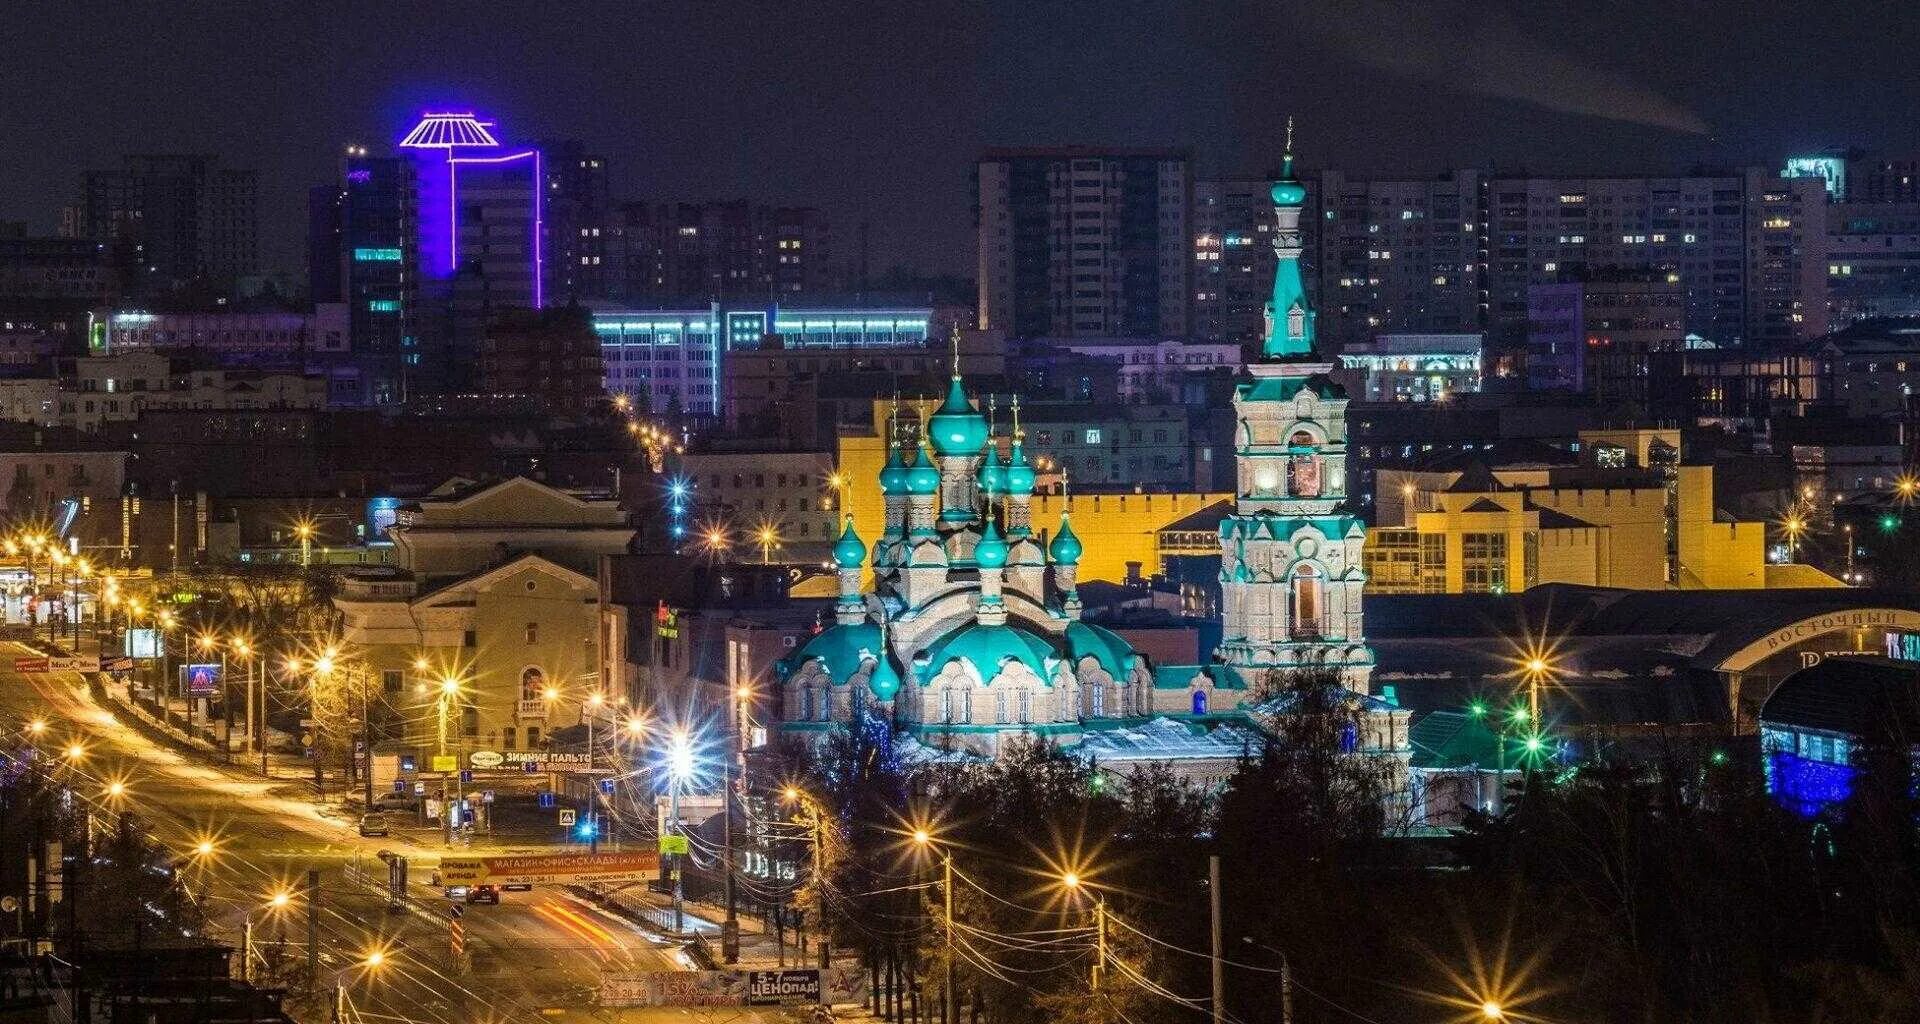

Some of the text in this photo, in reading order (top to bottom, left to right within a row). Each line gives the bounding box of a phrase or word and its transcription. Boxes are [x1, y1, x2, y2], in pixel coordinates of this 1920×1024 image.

[506, 752, 591, 763] ЗИМНИЕ ПАЛЬТО
[447, 872, 476, 880] АРЕНДА
[751, 981, 820, 996] ЦЕНОПАД!
